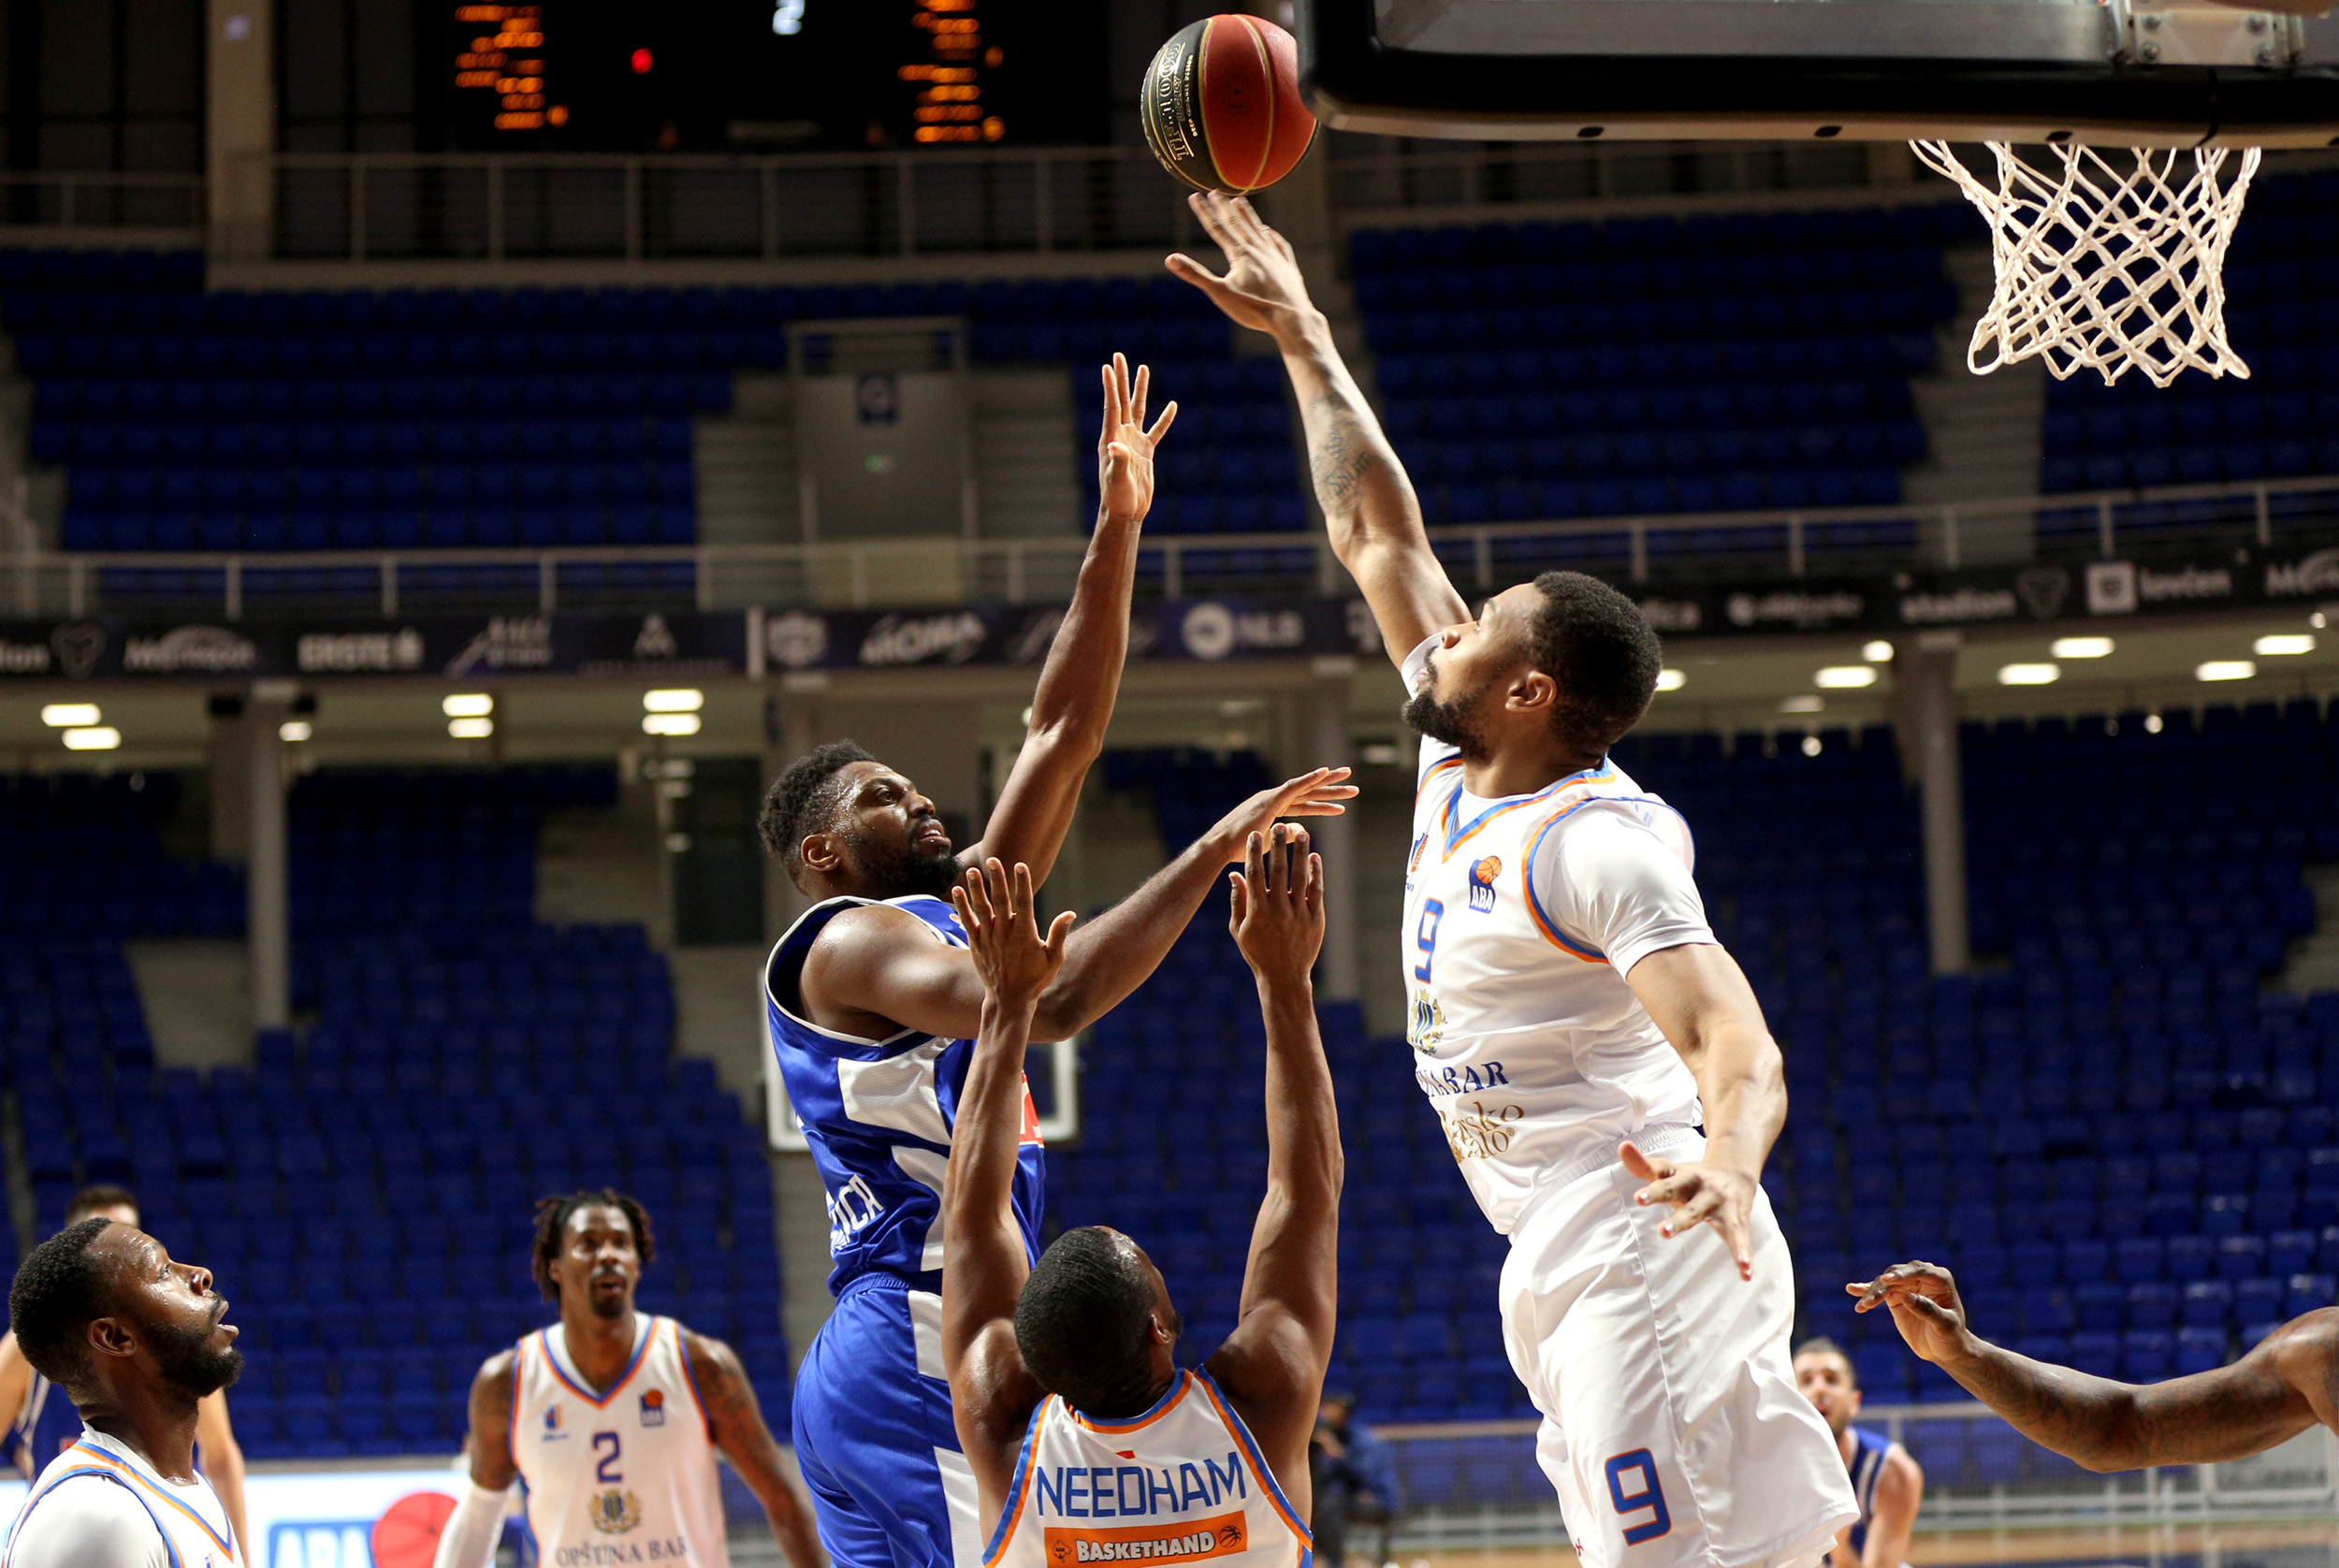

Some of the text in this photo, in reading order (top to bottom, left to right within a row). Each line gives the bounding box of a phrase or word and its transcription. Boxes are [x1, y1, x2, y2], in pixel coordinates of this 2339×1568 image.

[1184, 54, 1194, 81] DESIGN
[1188, 119, 1198, 137] DEEP
[1239, 613, 1304, 646] NLB
[298, 632, 391, 671] ERSTE
[1471, 885, 1493, 911] ABA
[1415, 896, 1445, 984] 9
[1442, 1061, 1509, 1094] BAR
[592, 1431, 623, 1483] 2
[1037, 1451, 1246, 1517] NEEDHAM
[1604, 1446, 1674, 1547] 9
[1075, 1531, 1216, 1563] BASKETHAND
